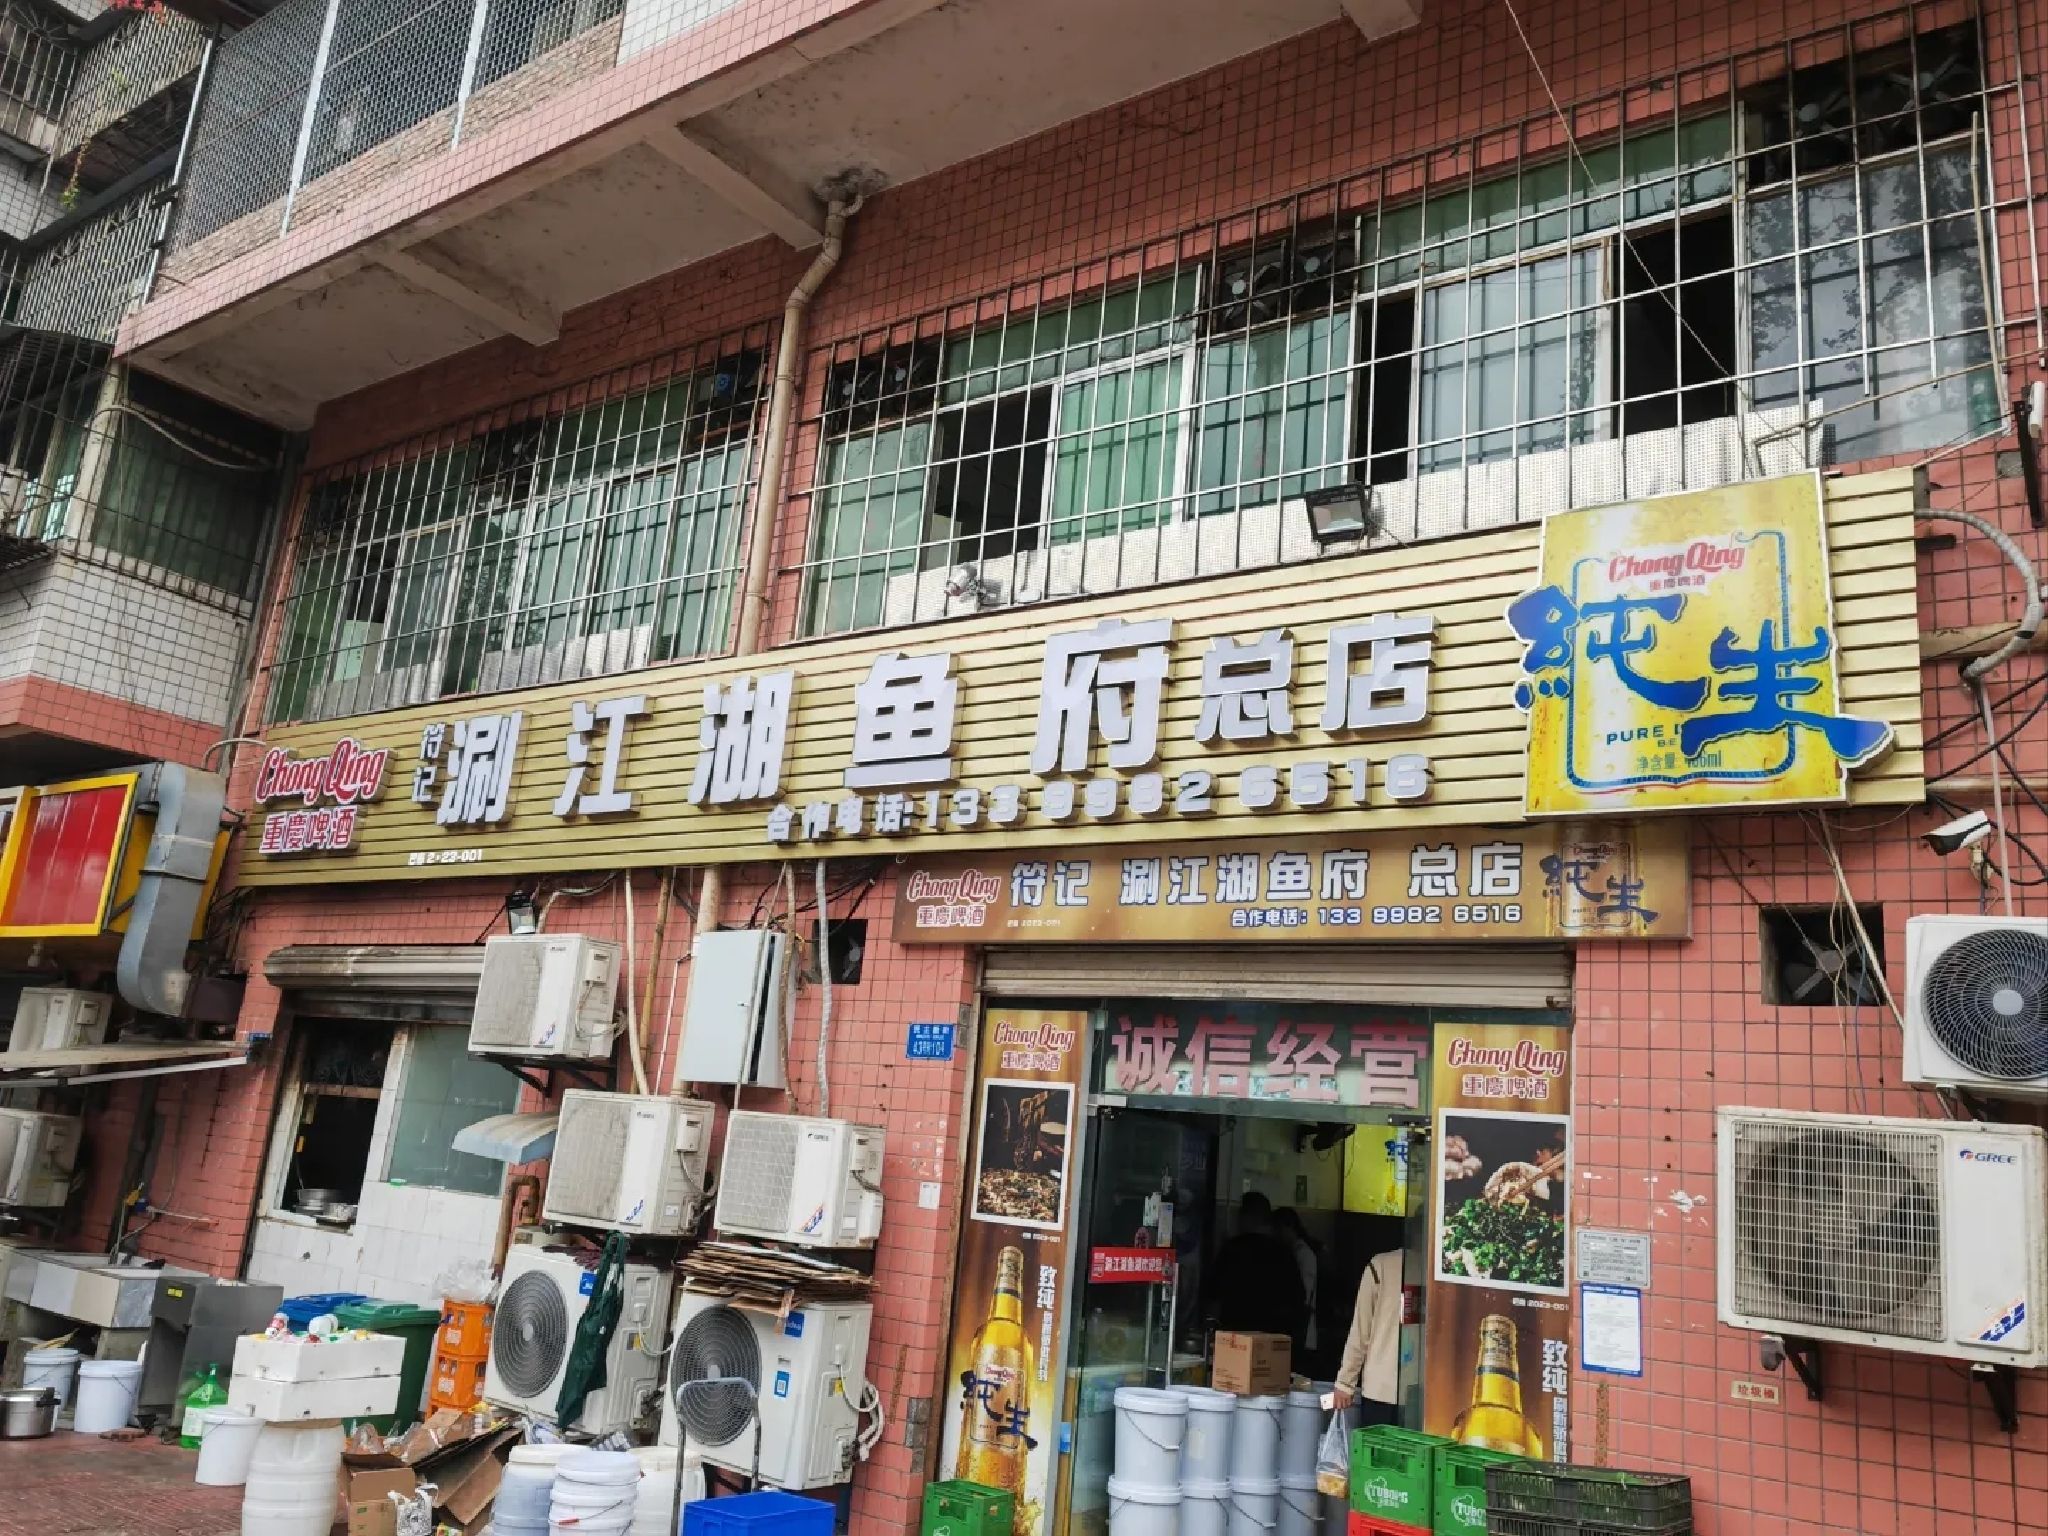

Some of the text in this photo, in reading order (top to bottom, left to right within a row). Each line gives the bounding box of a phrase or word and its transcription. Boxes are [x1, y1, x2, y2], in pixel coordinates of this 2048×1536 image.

[412, 723, 446, 802] 符记
[1607, 725, 1664, 745] PURE
[1011, 861, 1090, 906] 符记
[1408, 841, 1524, 897] 总店
[1317, 906, 1361, 925] 133
[1453, 904, 1522, 923] 6516
[1112, 1015, 1428, 1108] 诚信经营
[1542, 1339, 1568, 1395] 致纯
